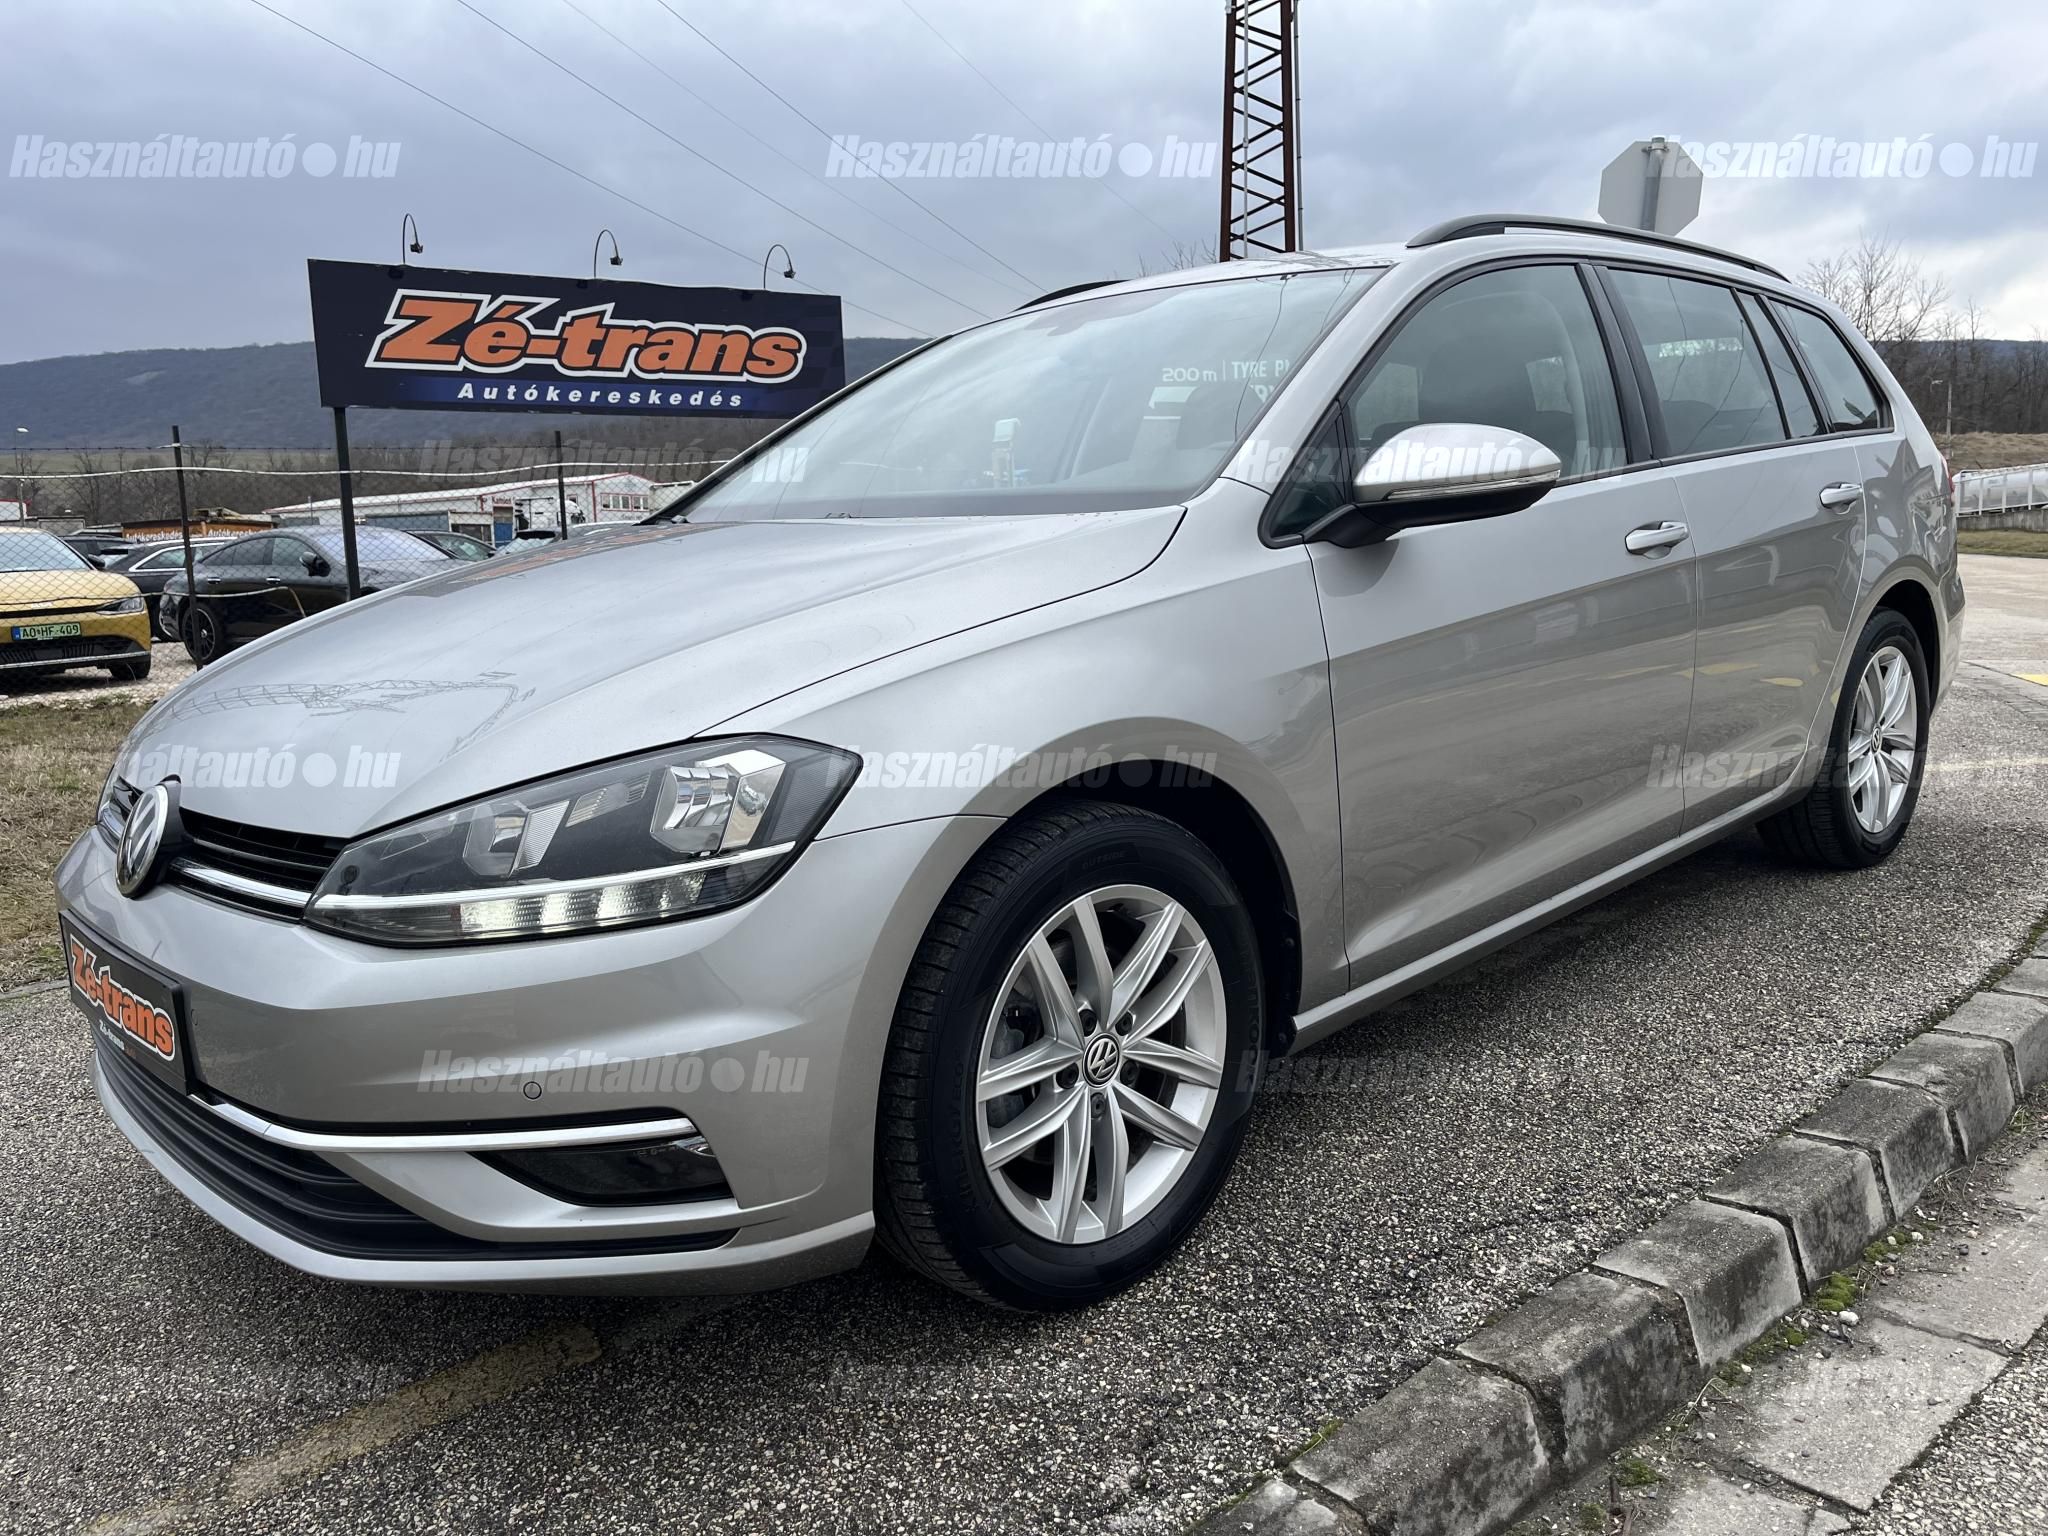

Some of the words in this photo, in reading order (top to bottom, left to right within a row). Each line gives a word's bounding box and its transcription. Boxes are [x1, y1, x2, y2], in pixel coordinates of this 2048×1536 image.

[367, 290, 806, 381] Zé-trans
[1162, 367, 1199, 382] 200
[1231, 360, 1268, 379] TYRE
[457, 382, 743, 407] Autókereskedés
[70, 935, 174, 1060] Zé-trans
